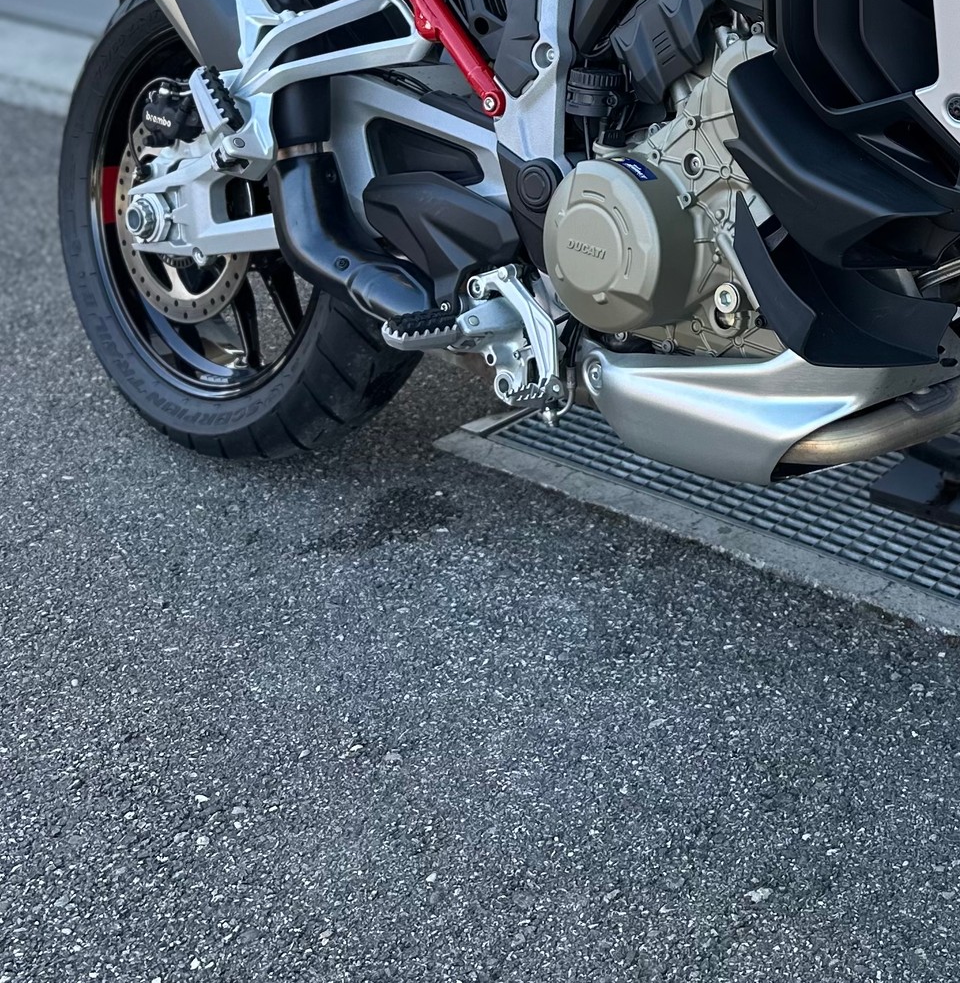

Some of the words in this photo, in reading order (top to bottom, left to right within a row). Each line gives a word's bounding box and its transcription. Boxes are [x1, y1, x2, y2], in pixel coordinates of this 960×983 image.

[145, 110, 172, 128] brembo
[567, 238, 607, 260] DUCATI
[95, 315, 147, 395] TRAIL
[143, 391, 264, 429] SCORPION
